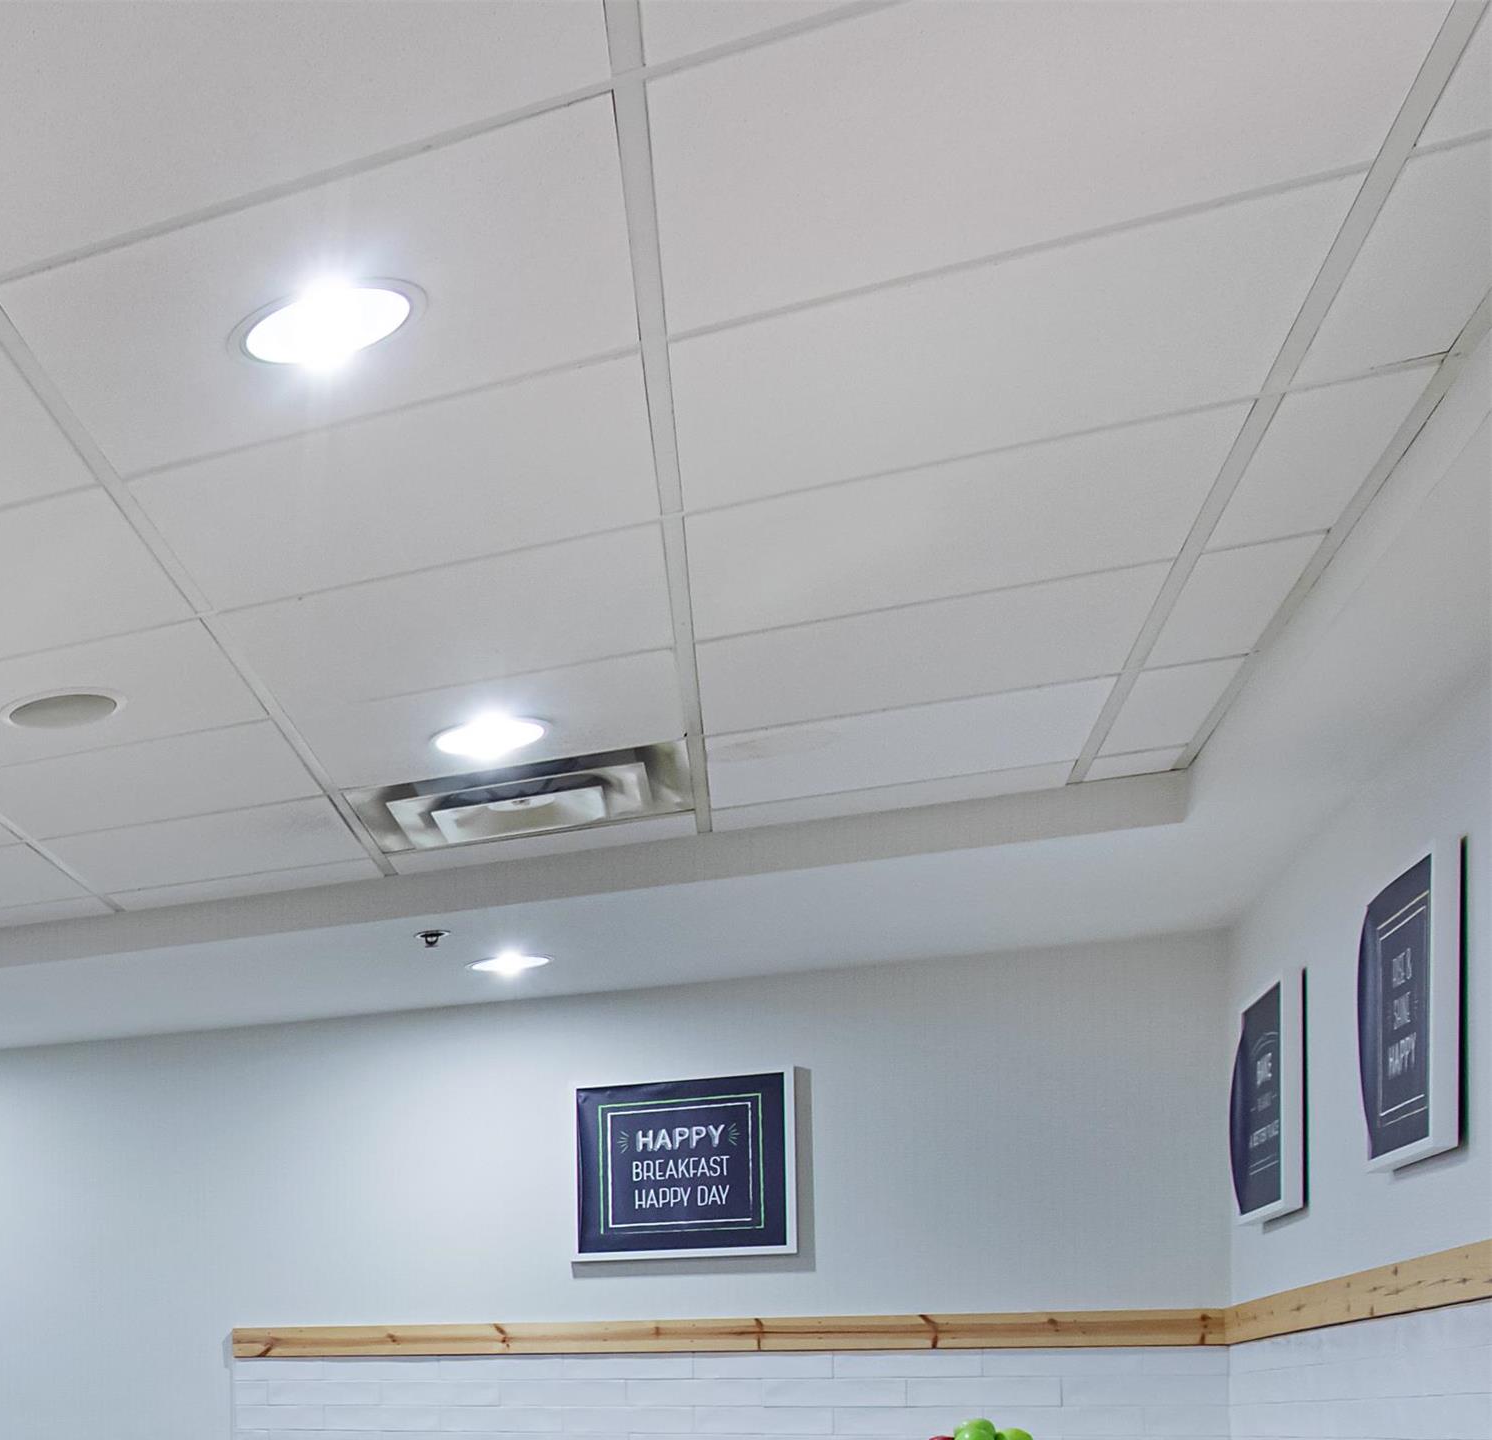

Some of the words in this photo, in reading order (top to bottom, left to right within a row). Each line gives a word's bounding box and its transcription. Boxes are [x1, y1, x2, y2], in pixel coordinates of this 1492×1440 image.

[635, 1124, 726, 1153] HAPPY
[632, 1155, 730, 1182] BREAKFAST
[634, 1186, 692, 1210] HAPPY
[697, 1184, 730, 1207] DAY
